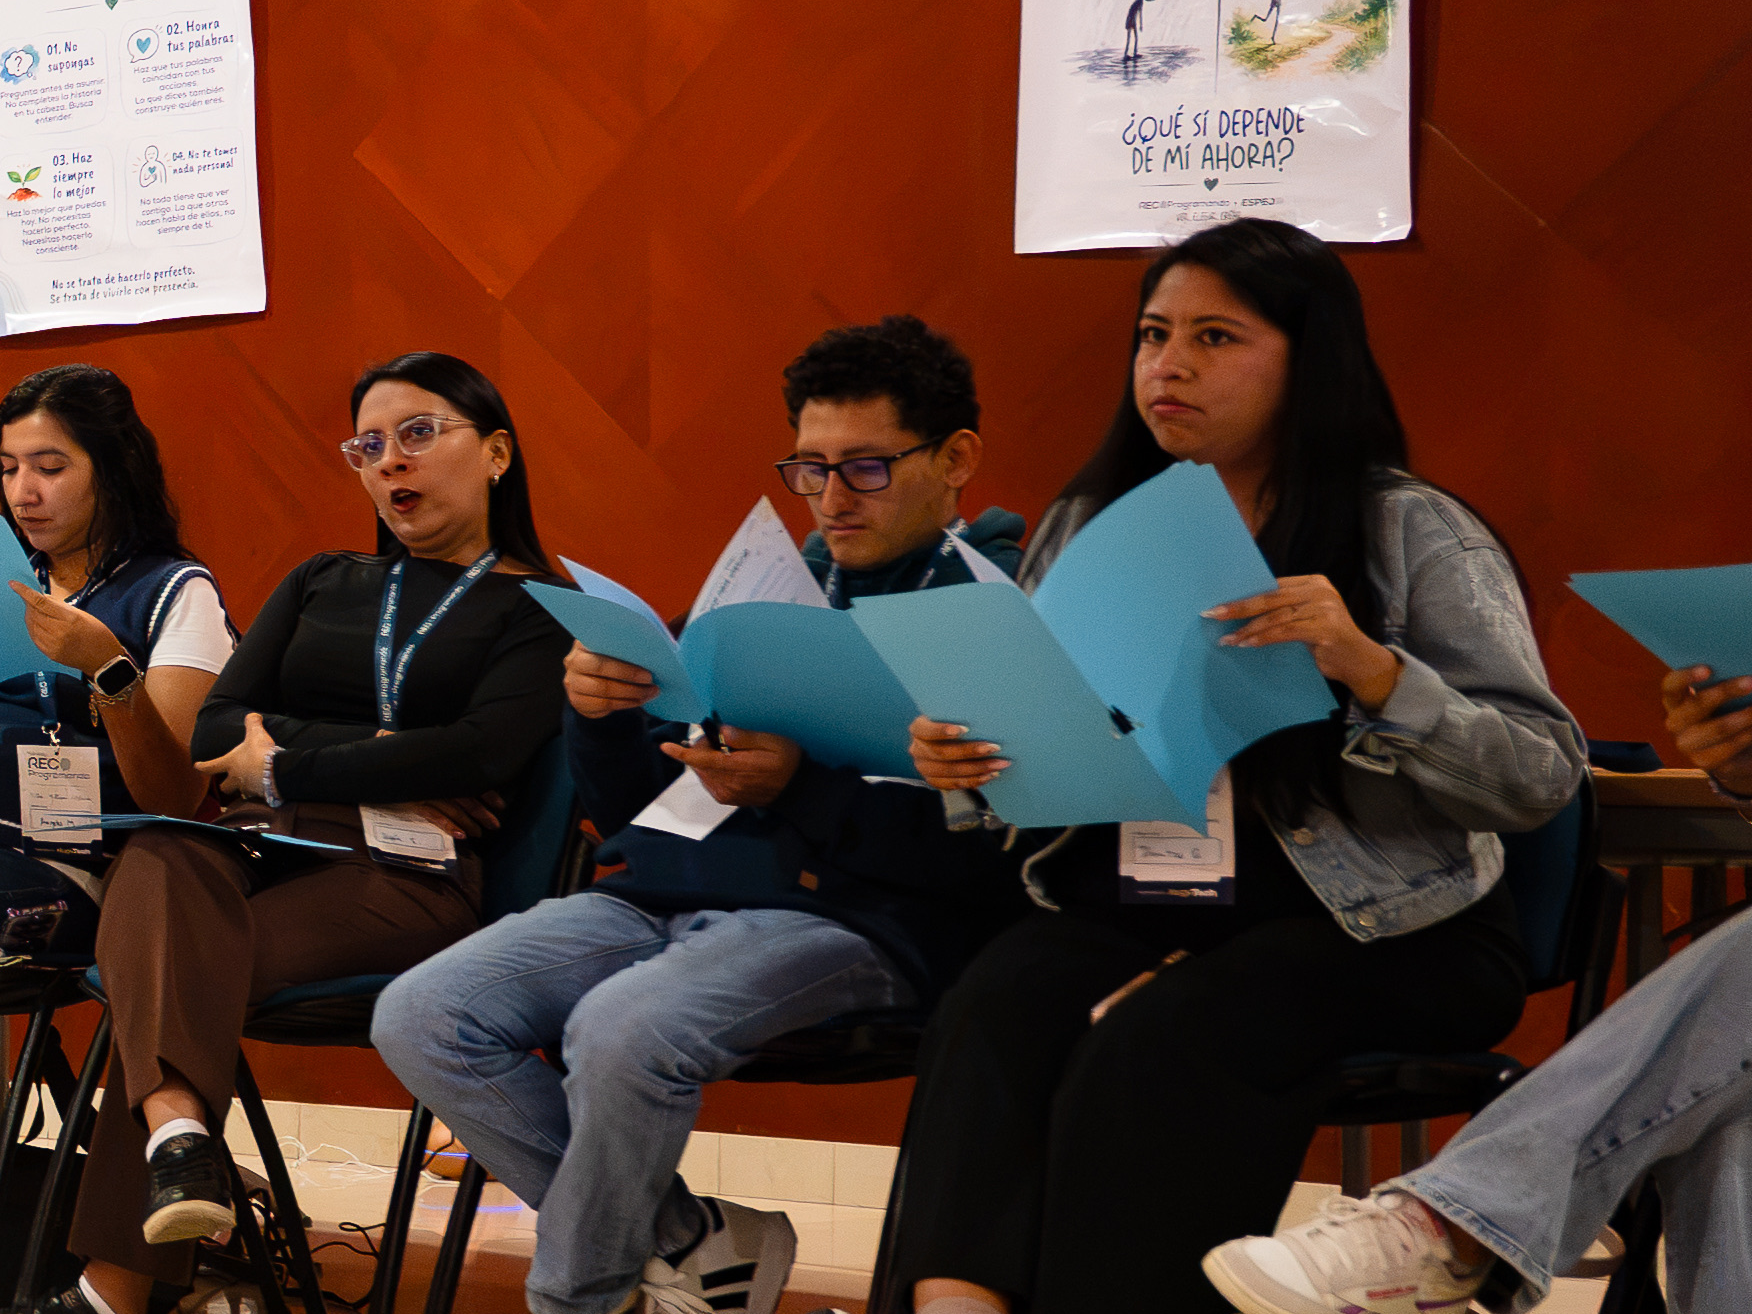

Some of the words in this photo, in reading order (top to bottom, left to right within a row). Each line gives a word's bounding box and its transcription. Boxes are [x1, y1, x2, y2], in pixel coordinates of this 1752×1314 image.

[167, 23, 183, 35] 02.
[186, 20, 220, 32] Honra
[47, 44, 61, 55] 01.
[65, 41, 77, 52] No
[168, 41, 184, 52] tus
[188, 33, 233, 53] palabras
[48, 57, 95, 73] supongas
[151, 65, 167, 73] que
[135, 97, 145, 105] Lo
[1123, 105, 1183, 145] ¿QUÉ
[1219, 106, 1306, 139] DEPENDE
[53, 155, 69, 167] 03.
[73, 152, 92, 163] Haz
[203, 149, 211, 157] te
[1132, 147, 1154, 175] DE
[1201, 138, 1294, 172] AHORA?
[173, 164, 194, 174] nada
[197, 157, 233, 174] personal
[53, 170, 94, 183] siempre
[53, 187, 62, 199] lo
[66, 185, 95, 199] mejor
[53, 280, 63, 289] No
[67, 280, 75, 288] se
[79, 276, 101, 287] trata
[105, 274, 115, 284] de
[118, 270, 151, 283] hacerlo
[154, 266, 195, 282] perfecto.
[50, 294, 60, 304] Se
[64, 293, 87, 303] trata
[90, 289, 99, 300] de
[103, 286, 131, 298] vivirlo
[135, 287, 150, 295] con
[153, 279, 198, 295] presencia.
